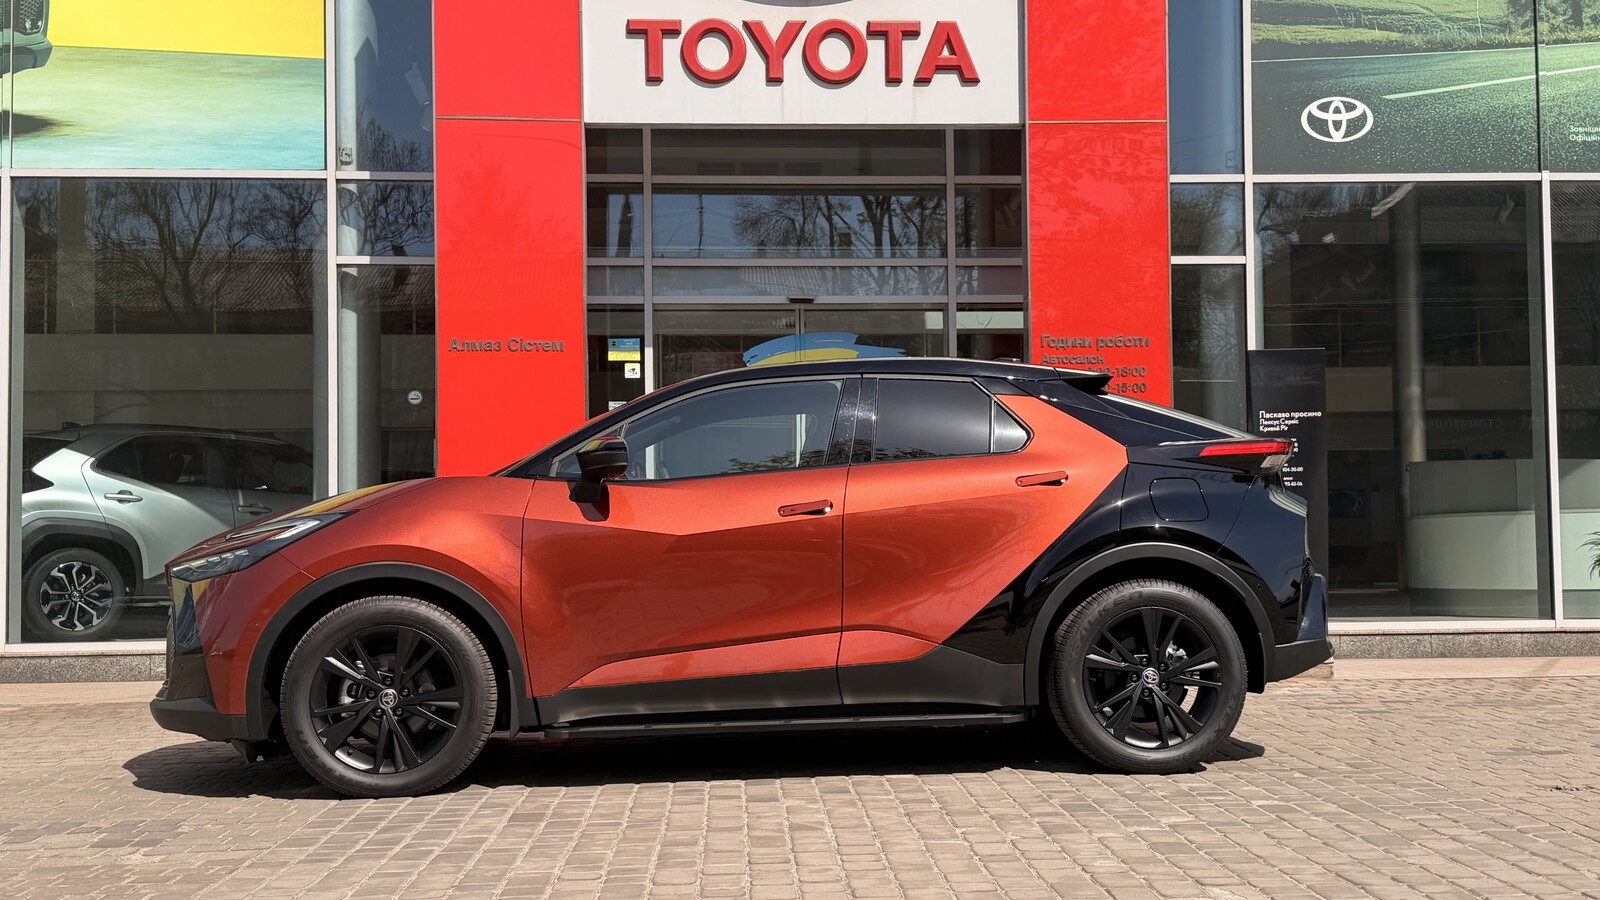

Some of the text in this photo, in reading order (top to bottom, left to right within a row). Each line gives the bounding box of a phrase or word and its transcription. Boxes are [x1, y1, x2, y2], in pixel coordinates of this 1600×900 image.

[626, 18, 980, 85] TOYOTA
[448, 337, 565, 352] Алмаз Сістем
[1041, 334, 1149, 351] Години роботи
[1041, 353, 1105, 365] Автосалон
[1259, 411, 1290, 419] Ласкаво
